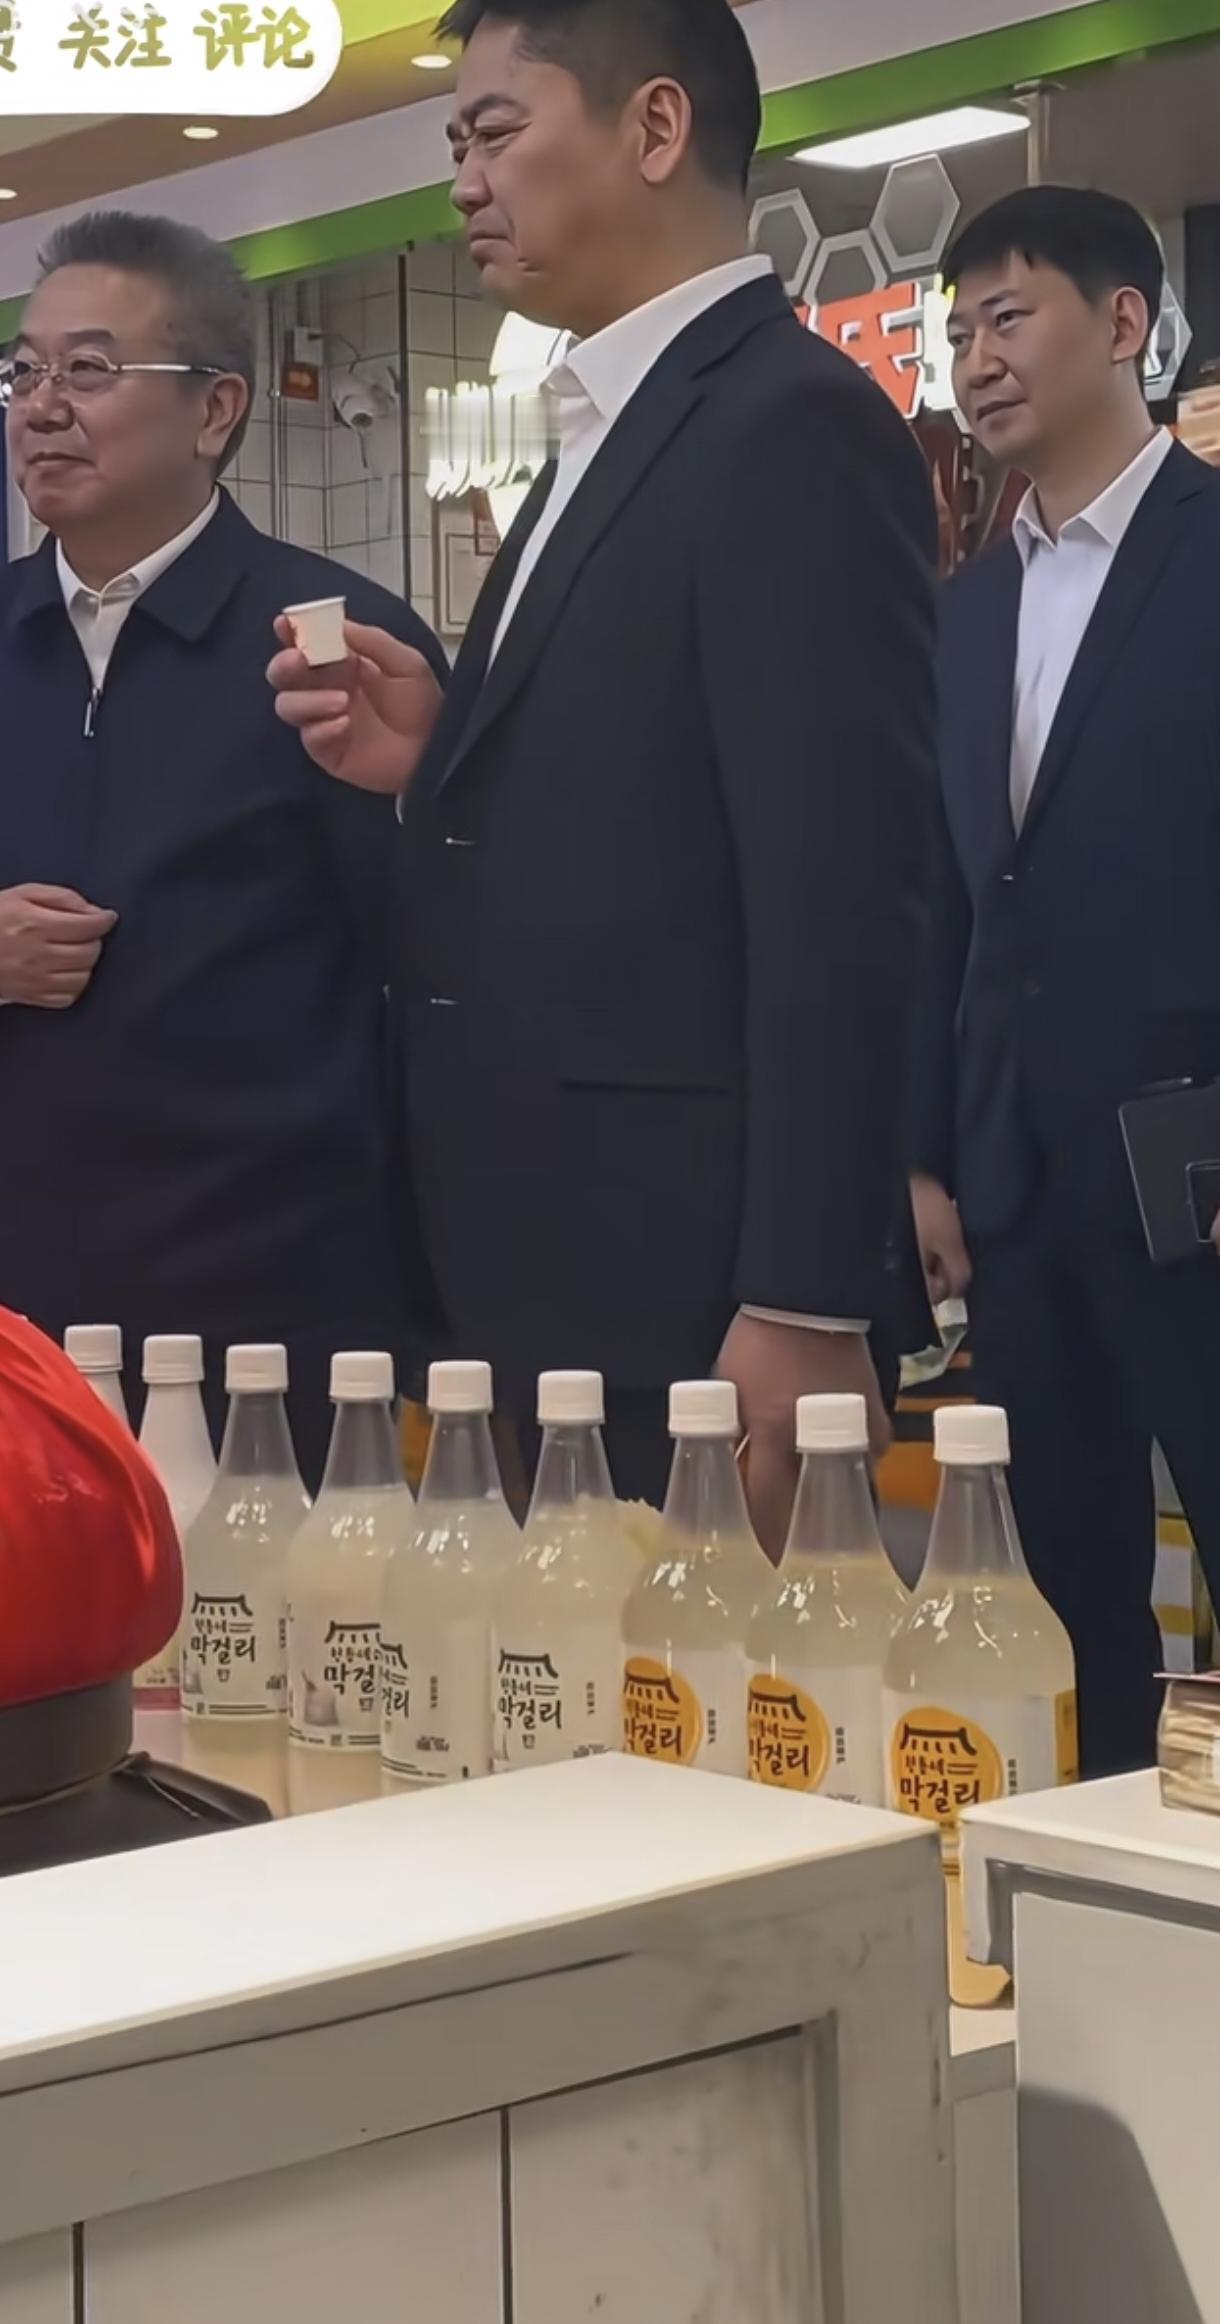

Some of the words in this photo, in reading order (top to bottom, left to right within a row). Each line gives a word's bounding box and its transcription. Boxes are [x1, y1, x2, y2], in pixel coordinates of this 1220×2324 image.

[190, 1633, 256, 1666] 막걸리
[324, 1662, 377, 1695] 막걸
[498, 1695, 562, 1731] 막걸리
[899, 1774, 981, 1814] 막걸리
